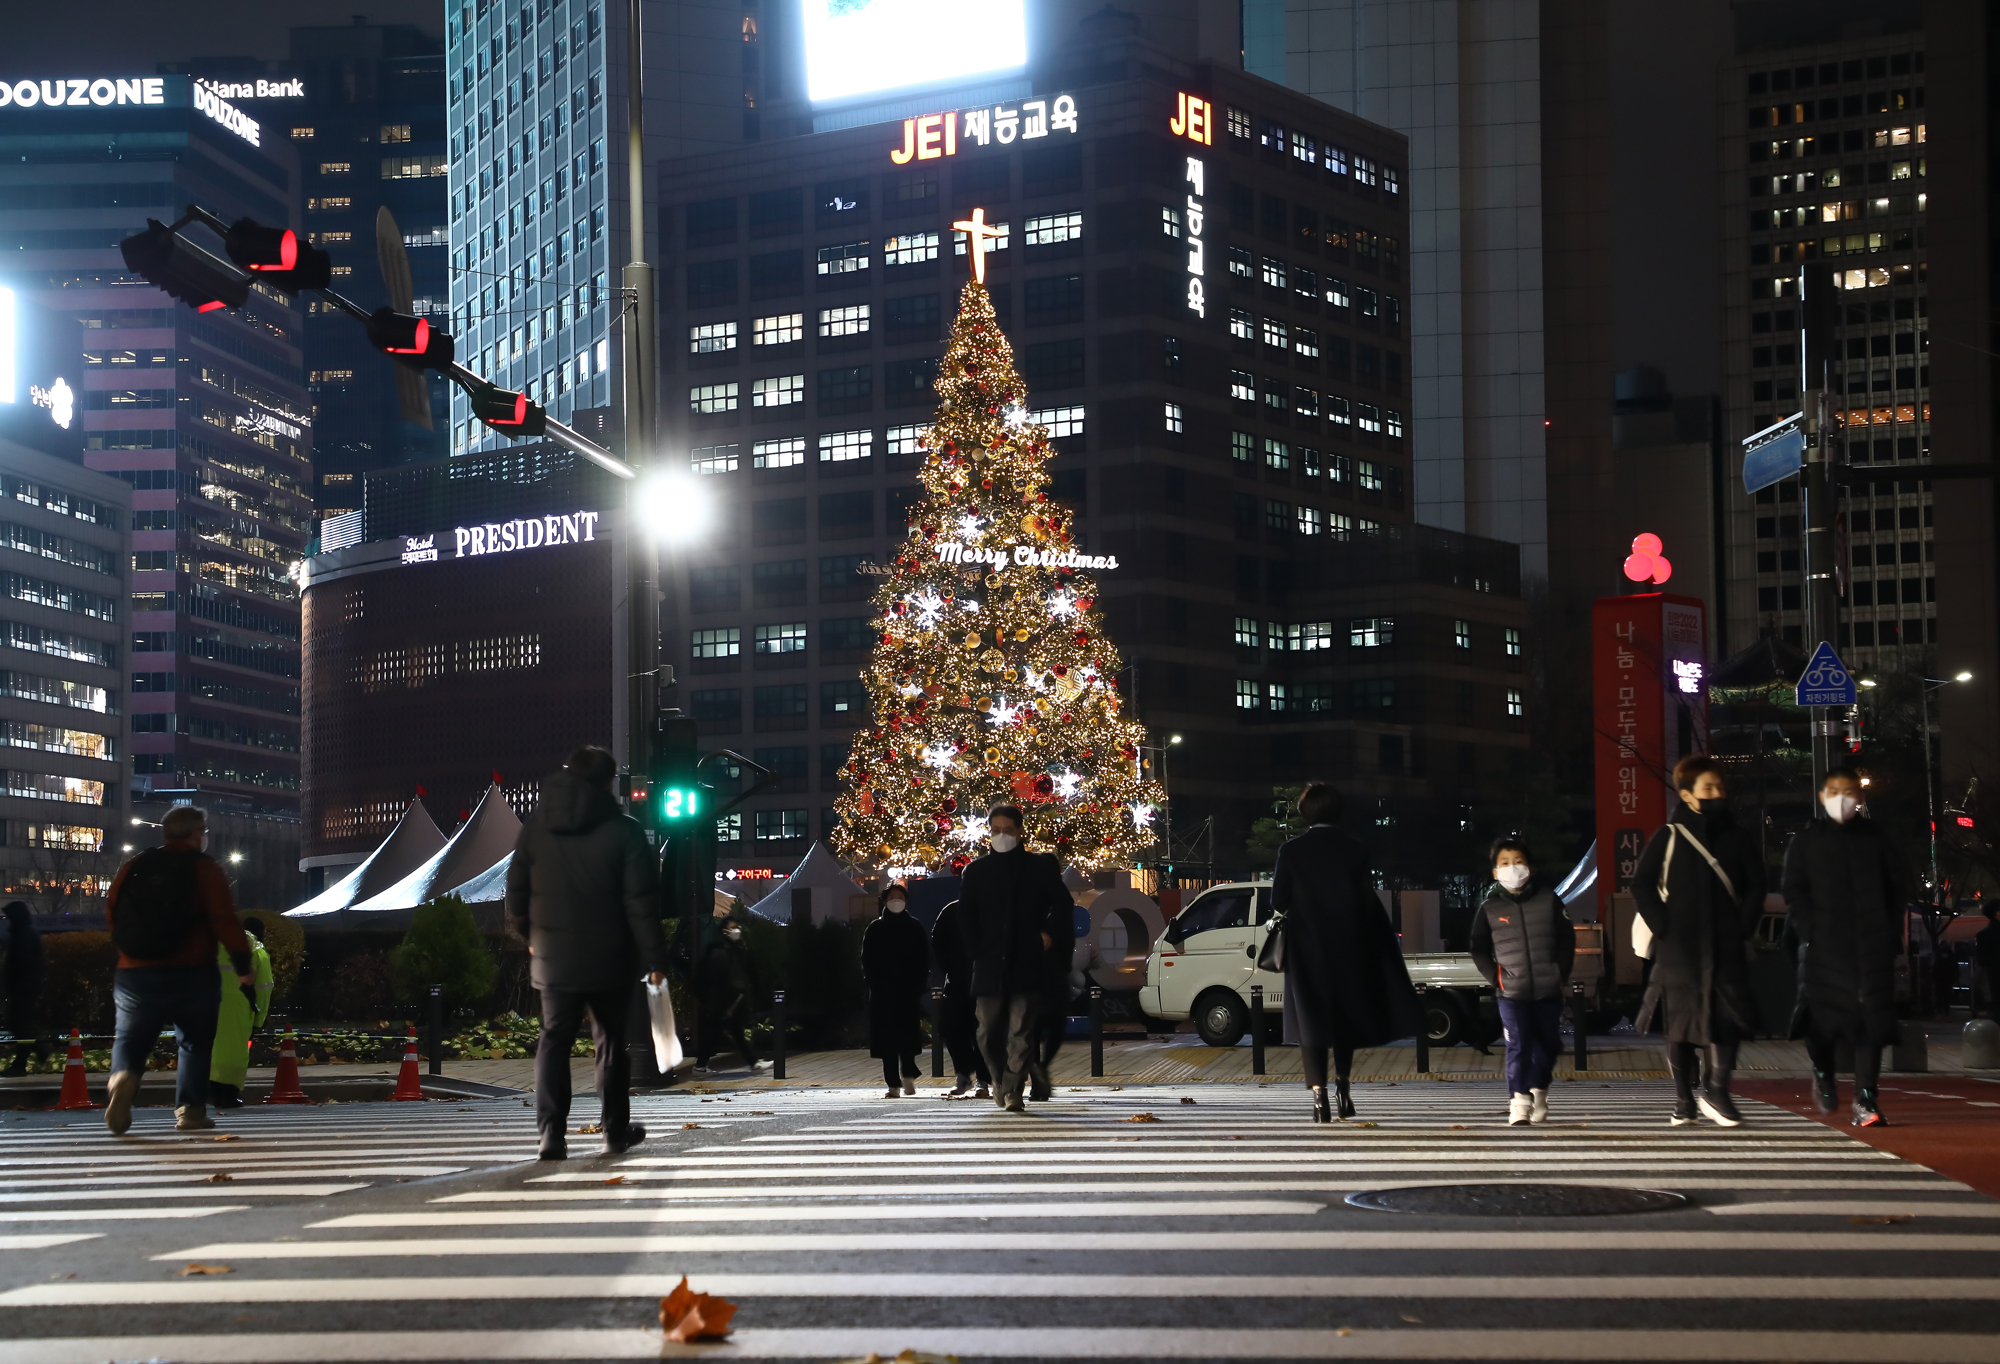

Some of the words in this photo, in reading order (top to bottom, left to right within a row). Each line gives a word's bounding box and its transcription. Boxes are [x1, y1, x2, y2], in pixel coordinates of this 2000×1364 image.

[204, 80, 254, 98] Hana
[256, 78, 304, 98] Bank
[193, 82, 260, 148] DOUZONE
[890, 111, 957, 165] JEI
[964, 94, 1078, 146] 재능교육
[1170, 91, 1212, 146] JEI
[1186, 156, 1204, 319] 재능교육
[406, 534, 434, 551] Hotel
[455, 511, 598, 558] PRESIDENT
[935, 542, 1009, 572] Merry
[1013, 545, 1119, 570] Christmas
[1805, 692, 1846, 703] 자전거횡단
[666, 789, 696, 817] 21
[1619, 767, 1638, 814] 위한
[736, 869, 772, 880] 구이구이
